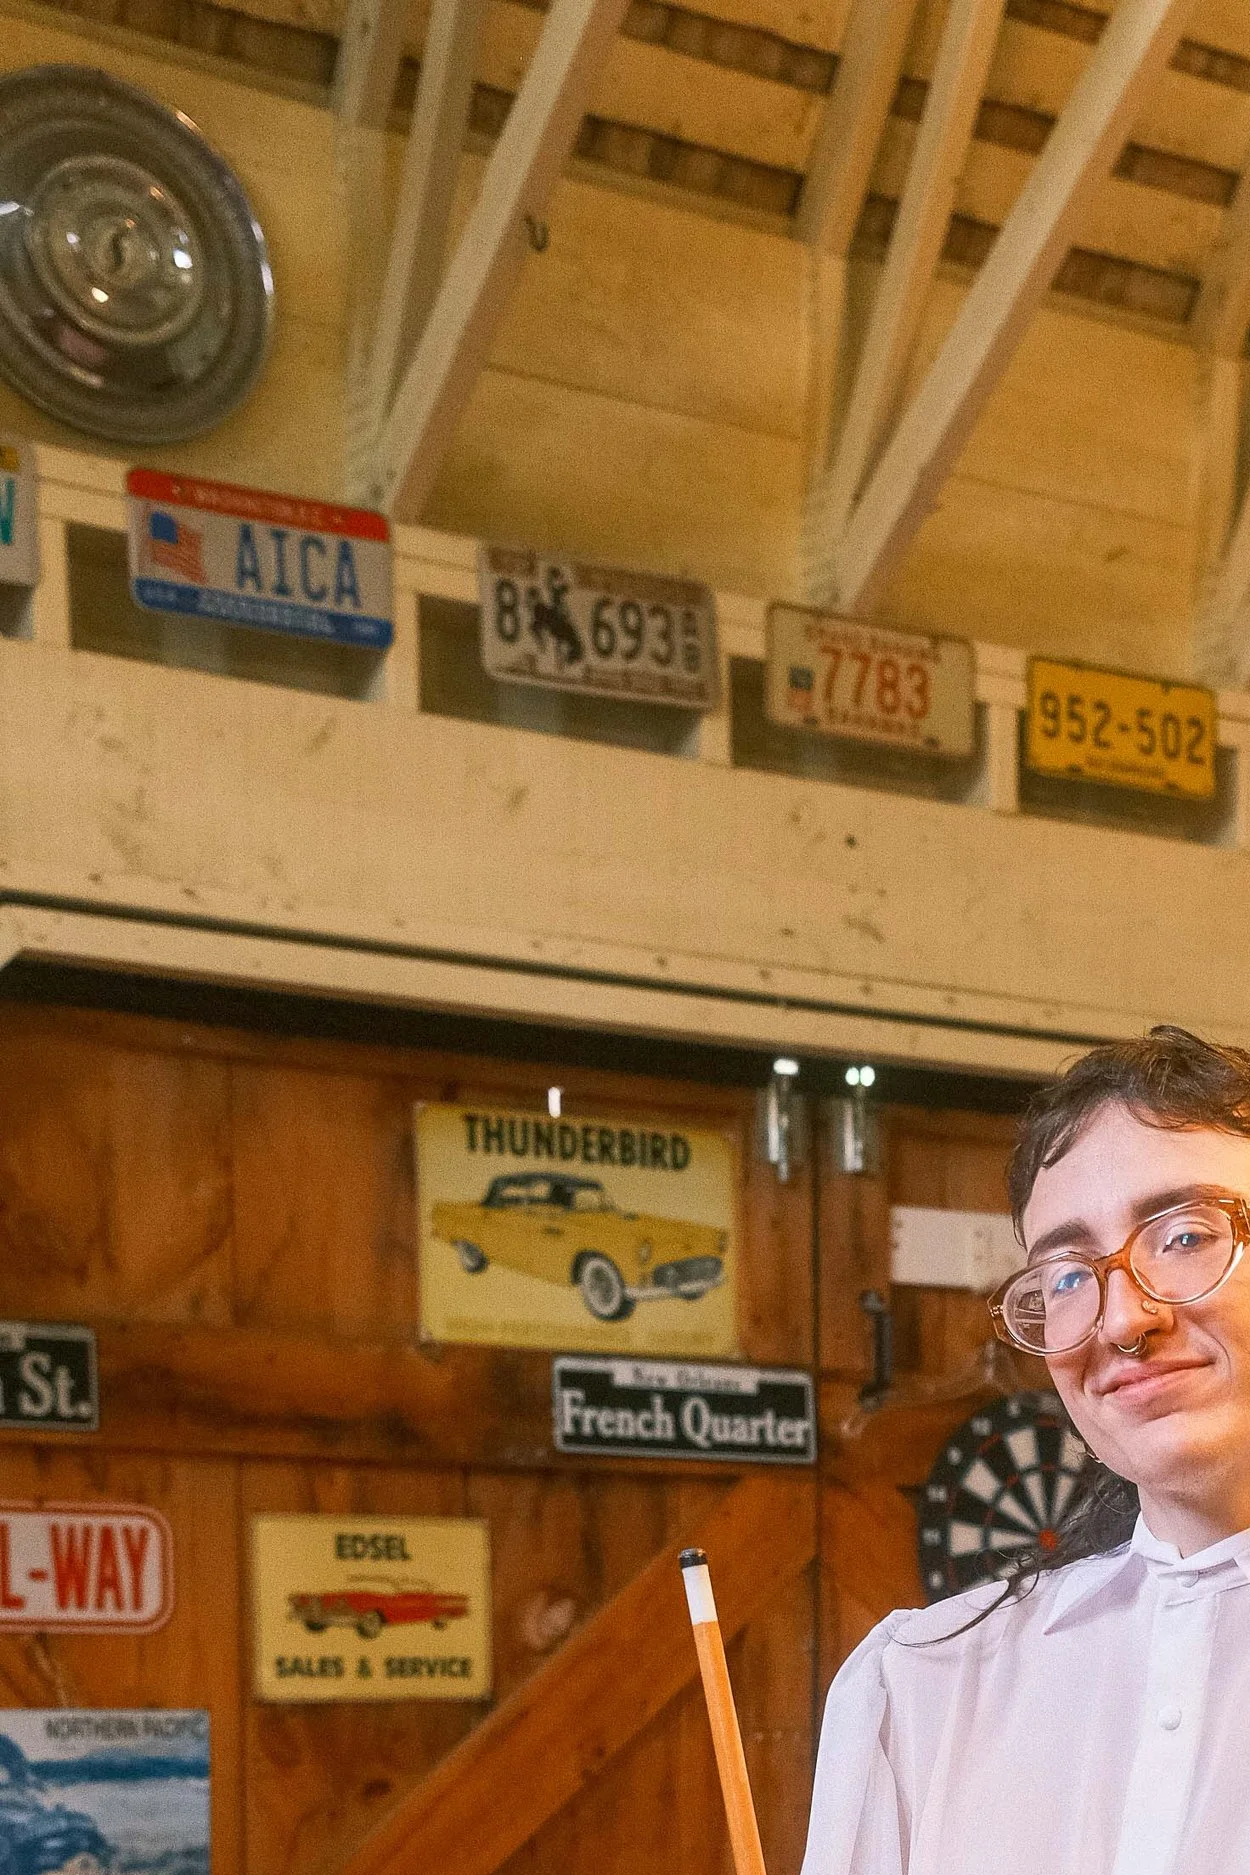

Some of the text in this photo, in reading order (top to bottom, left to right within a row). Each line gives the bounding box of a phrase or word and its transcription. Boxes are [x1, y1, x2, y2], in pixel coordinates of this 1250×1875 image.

[236, 522, 362, 609] AICA
[591, 597, 676, 668] 693
[819, 645, 932, 721] 7783
[1039, 689, 1207, 766] 952-502
[463, 1112, 692, 1172] THUNDERBIRD
[18, 1351, 92, 1418] St.
[562, 1388, 812, 1449] French Quarter
[334, 1532, 413, 1562] EDSEL
[275, 1655, 345, 1680] SALES
[383, 1655, 473, 1679] SERVICE
